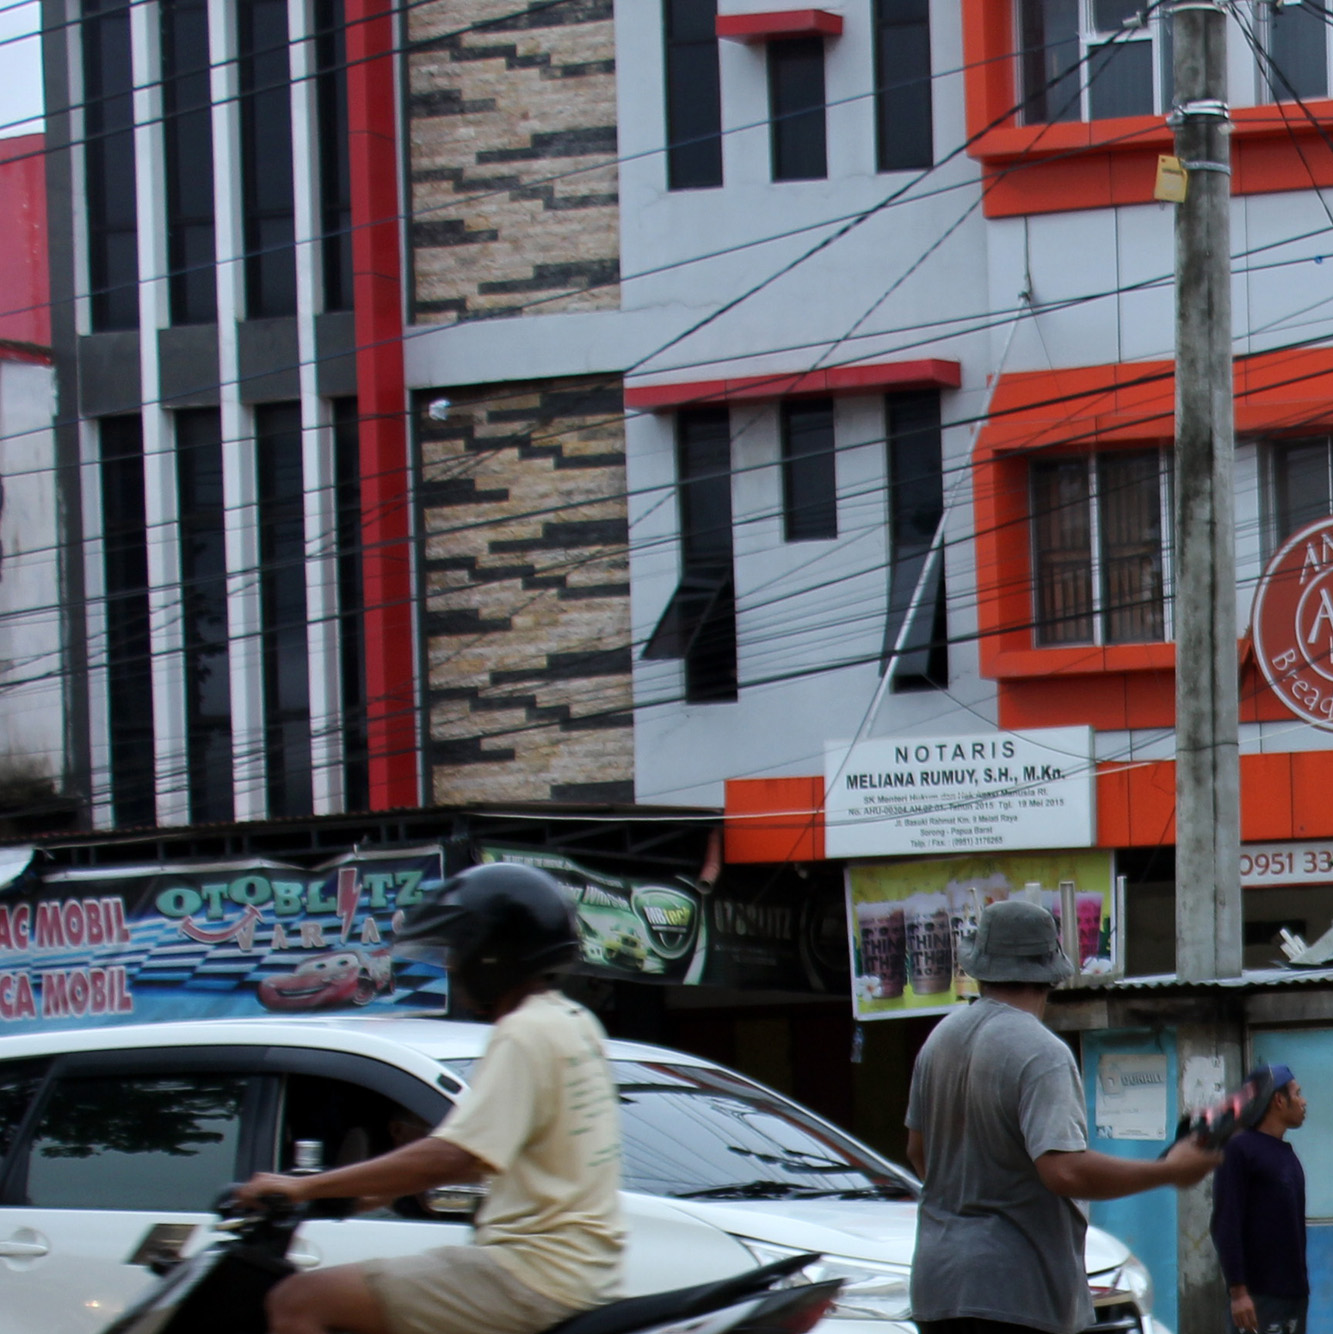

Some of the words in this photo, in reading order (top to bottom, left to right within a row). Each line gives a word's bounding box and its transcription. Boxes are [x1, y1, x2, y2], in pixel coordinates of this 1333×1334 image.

[894, 740, 1016, 764] NOTARIS
[846, 774, 915, 791] MELIANA
[919, 769, 979, 787] RUMUY,
[1239, 851, 1295, 877] 0951
[36, 897, 131, 948] MOBIL
[42, 965, 134, 1019] MOBIL
